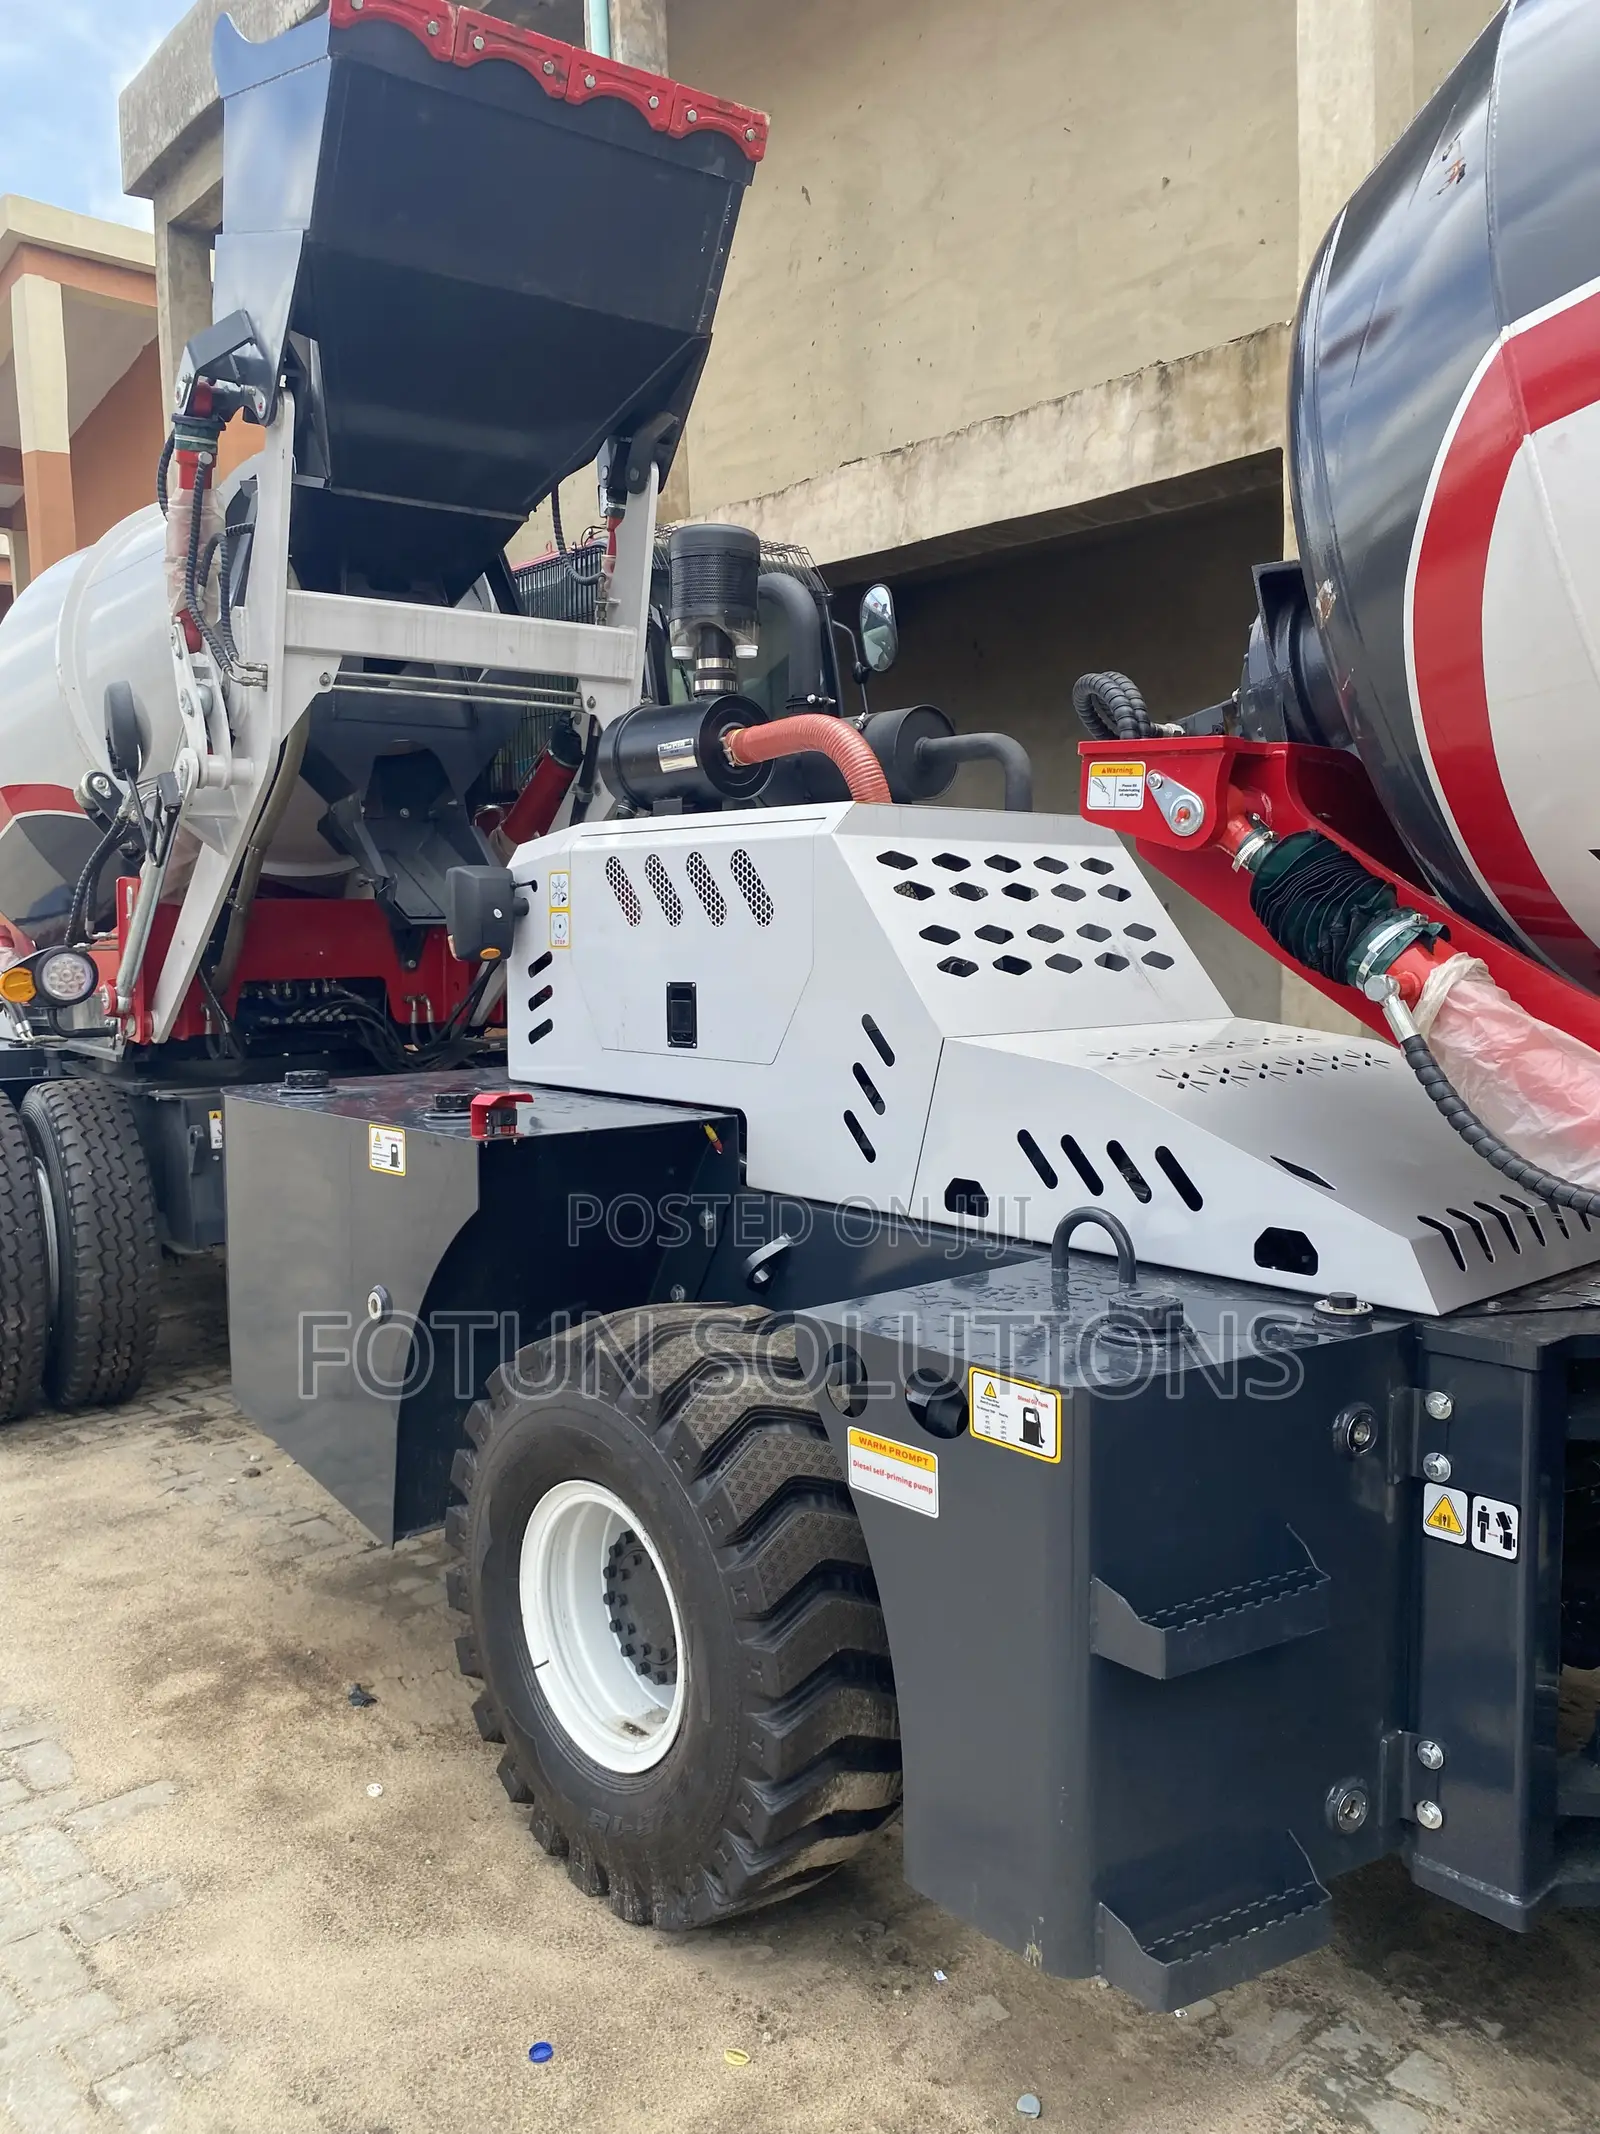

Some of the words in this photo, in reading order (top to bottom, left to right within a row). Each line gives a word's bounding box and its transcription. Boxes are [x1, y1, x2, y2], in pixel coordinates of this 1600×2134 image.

[1107, 766, 1134, 775] Warning
[1017, 1394, 1031, 1404] Diesel
[1038, 1401, 1049, 1409] Tank
[858, 1436, 887, 1453] WARM
[888, 1446, 929, 1466] PROMPT
[852, 1459, 872, 1472] Diesel
[873, 1467, 913, 1489] self-priming
[913, 1482, 933, 1495] pump
